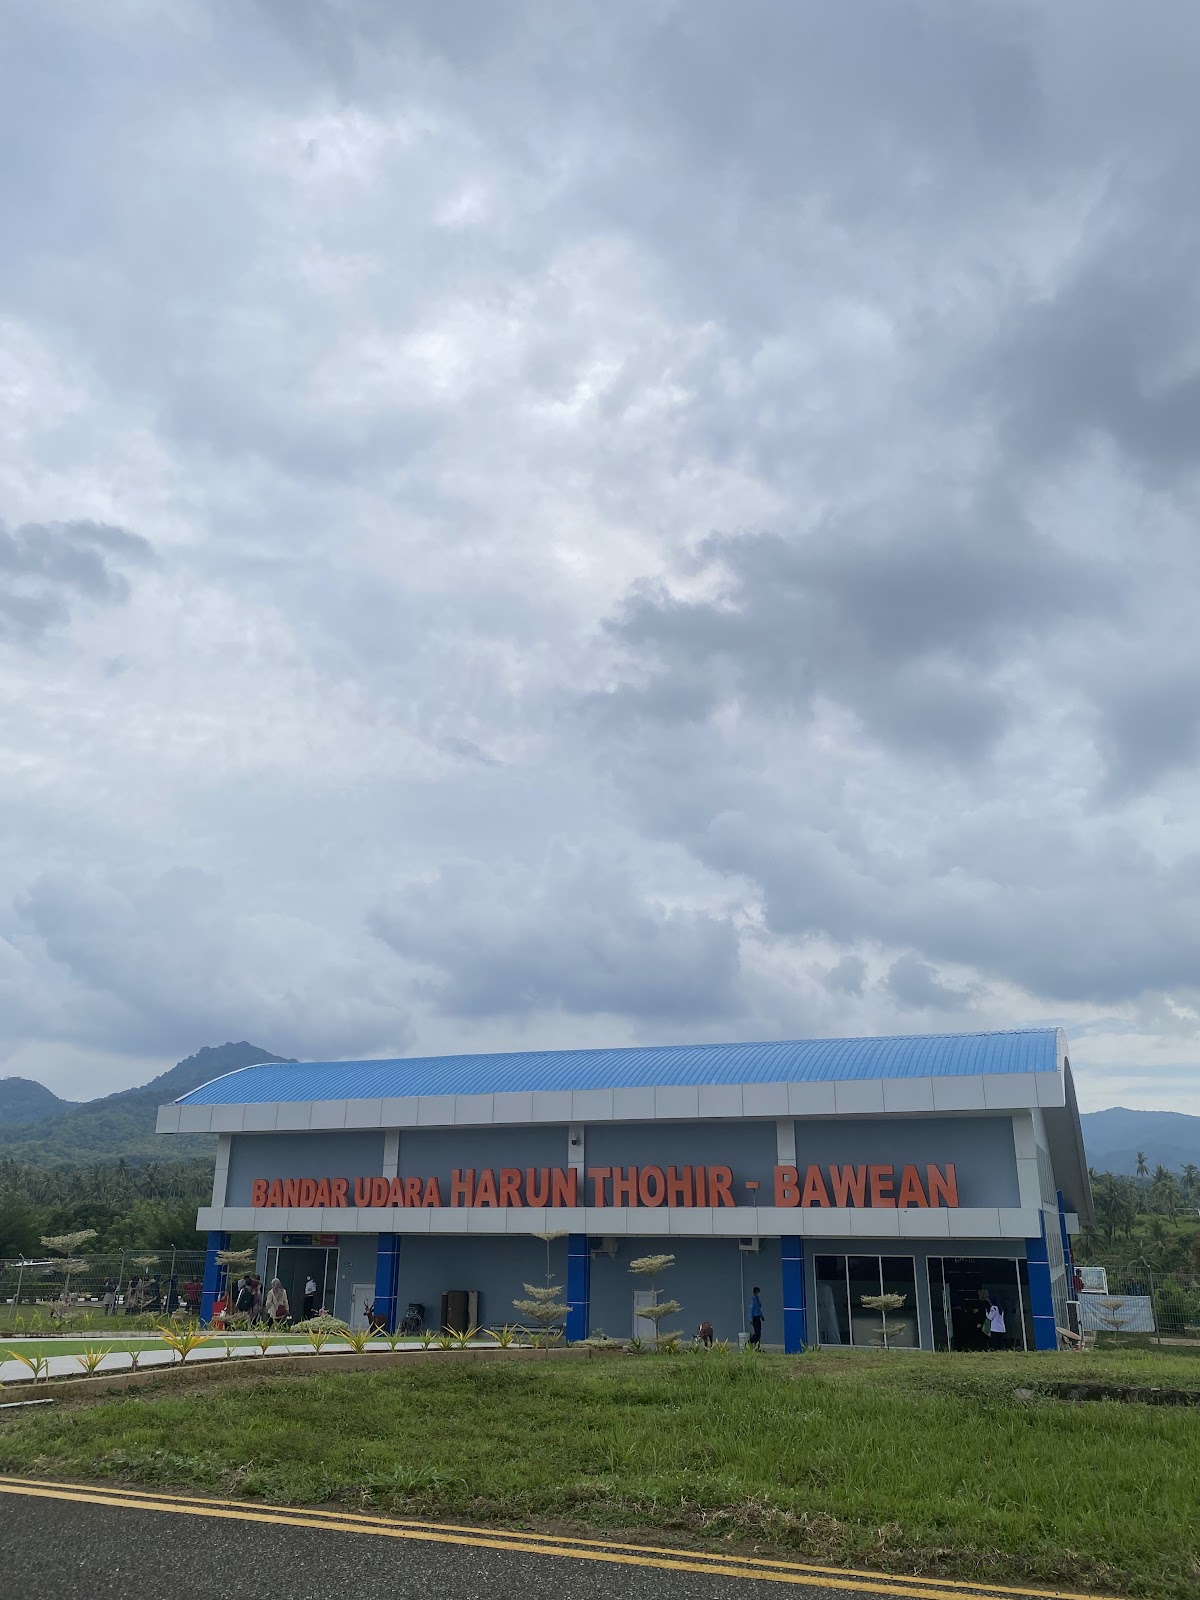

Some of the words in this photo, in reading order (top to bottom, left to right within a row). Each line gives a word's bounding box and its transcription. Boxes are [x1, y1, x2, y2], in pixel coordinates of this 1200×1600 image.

[251, 1177, 349, 1208] BANDAR
[354, 1177, 442, 1208] UDARA
[451, 1168, 578, 1208] HARUN
[587, 1165, 737, 1207] THOHIR
[745, 1181, 760, 1189] -
[773, 1164, 959, 1208] BAWEAN
